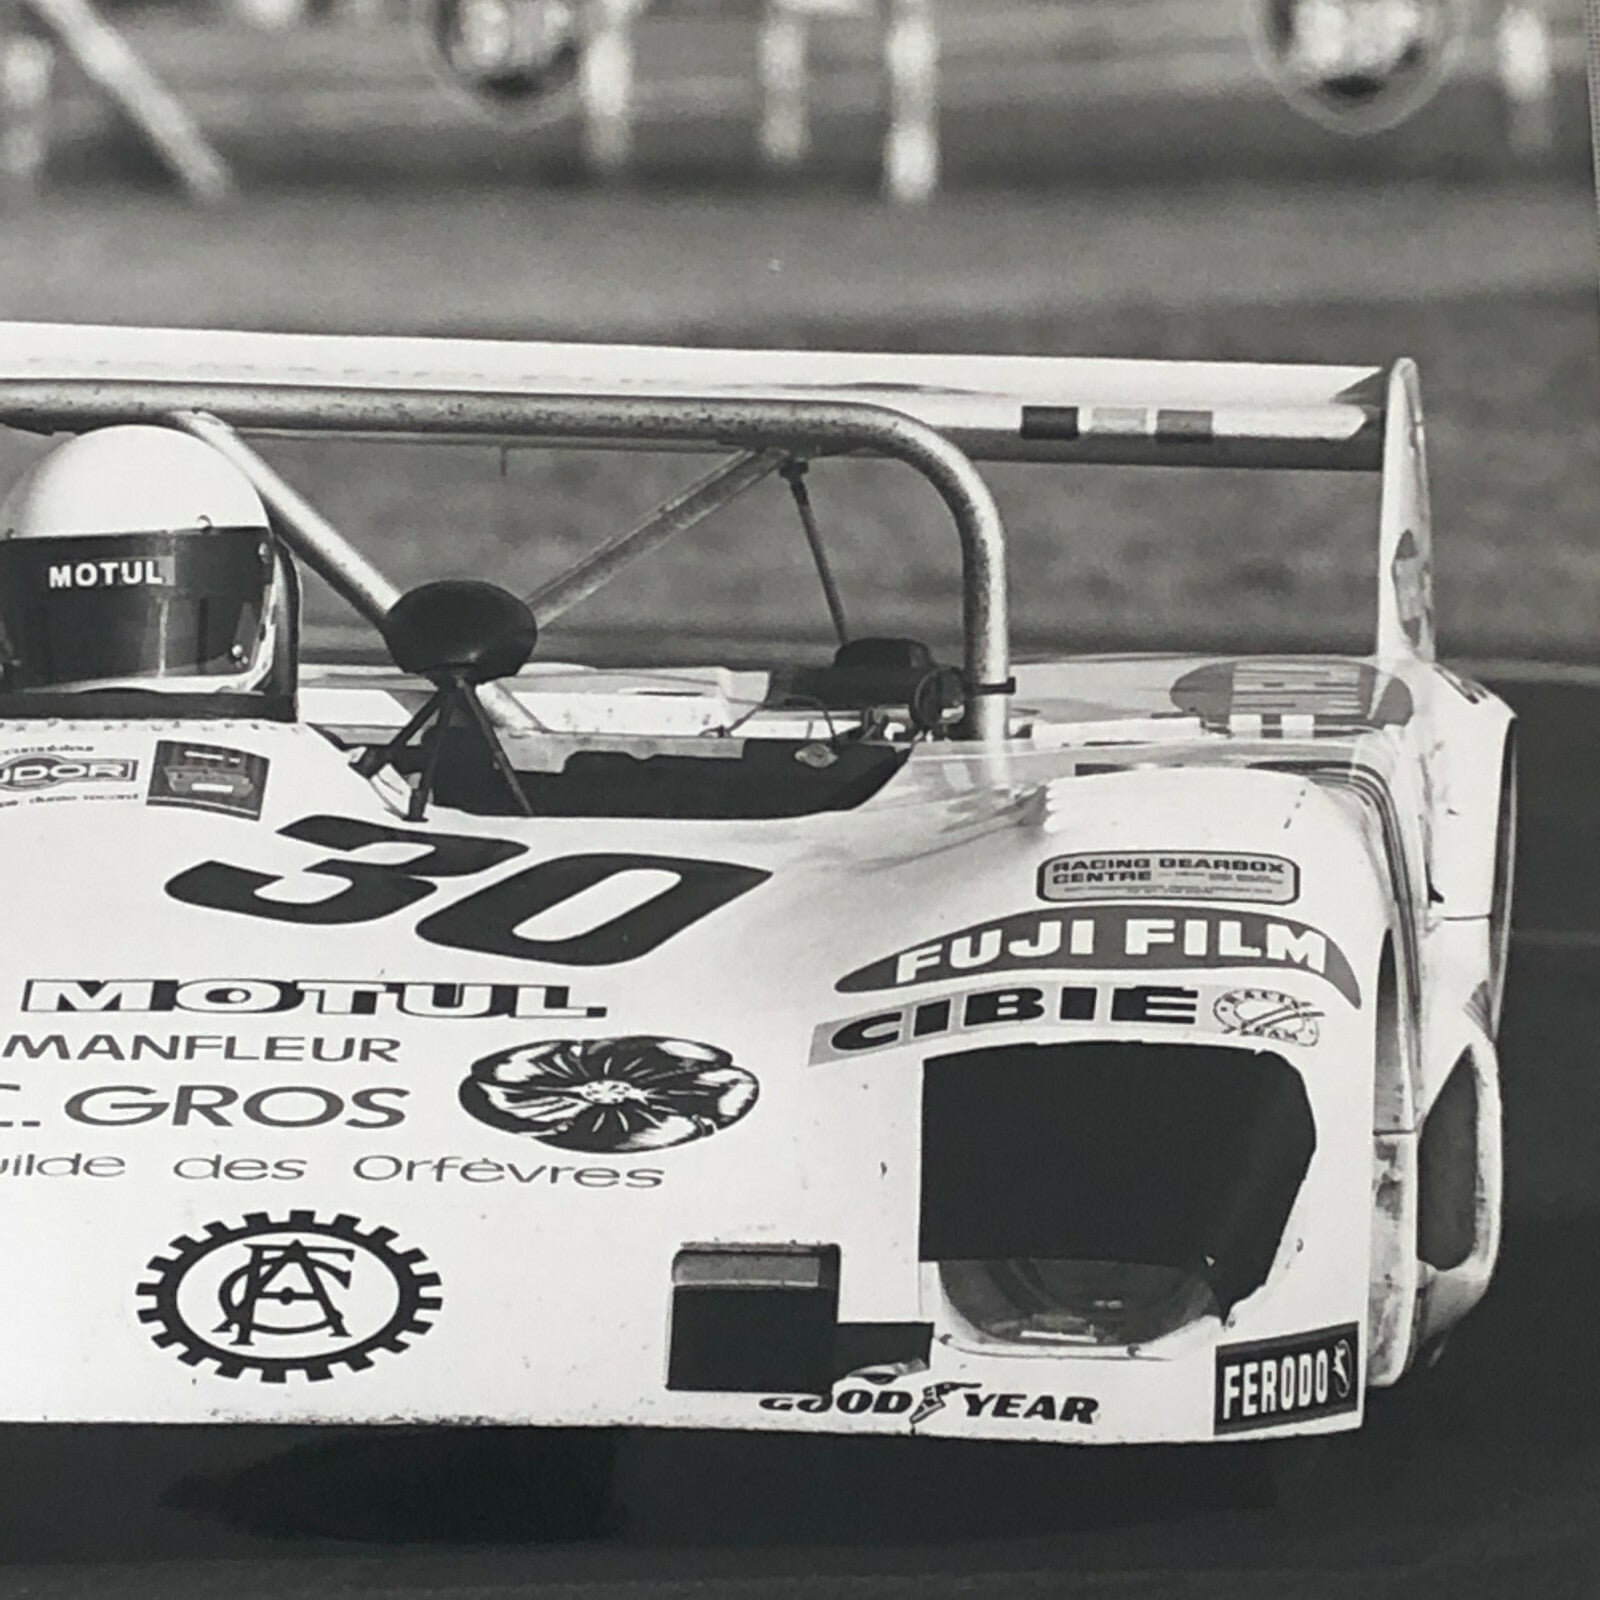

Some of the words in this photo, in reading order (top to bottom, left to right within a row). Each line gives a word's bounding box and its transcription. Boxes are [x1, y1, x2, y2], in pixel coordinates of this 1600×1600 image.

[49, 561, 163, 588] MOTUL
[1052, 858, 1151, 872] RACING
[1052, 870, 1152, 885] CENTRE
[164, 815, 773, 966] 30
[896, 919, 1095, 984] FUJI
[1125, 919, 1326, 974] FILM
[23, 979, 608, 1018] MOTUL
[2, 1034, 401, 1062] MANFLEUR
[64, 1085, 411, 1128] GROS
[173, 1153, 308, 1181] des
[353, 1155, 666, 1188] Orfèvres
[1223, 1349, 1329, 1419] FERODO
[962, 1392, 1100, 1425] YEAR
